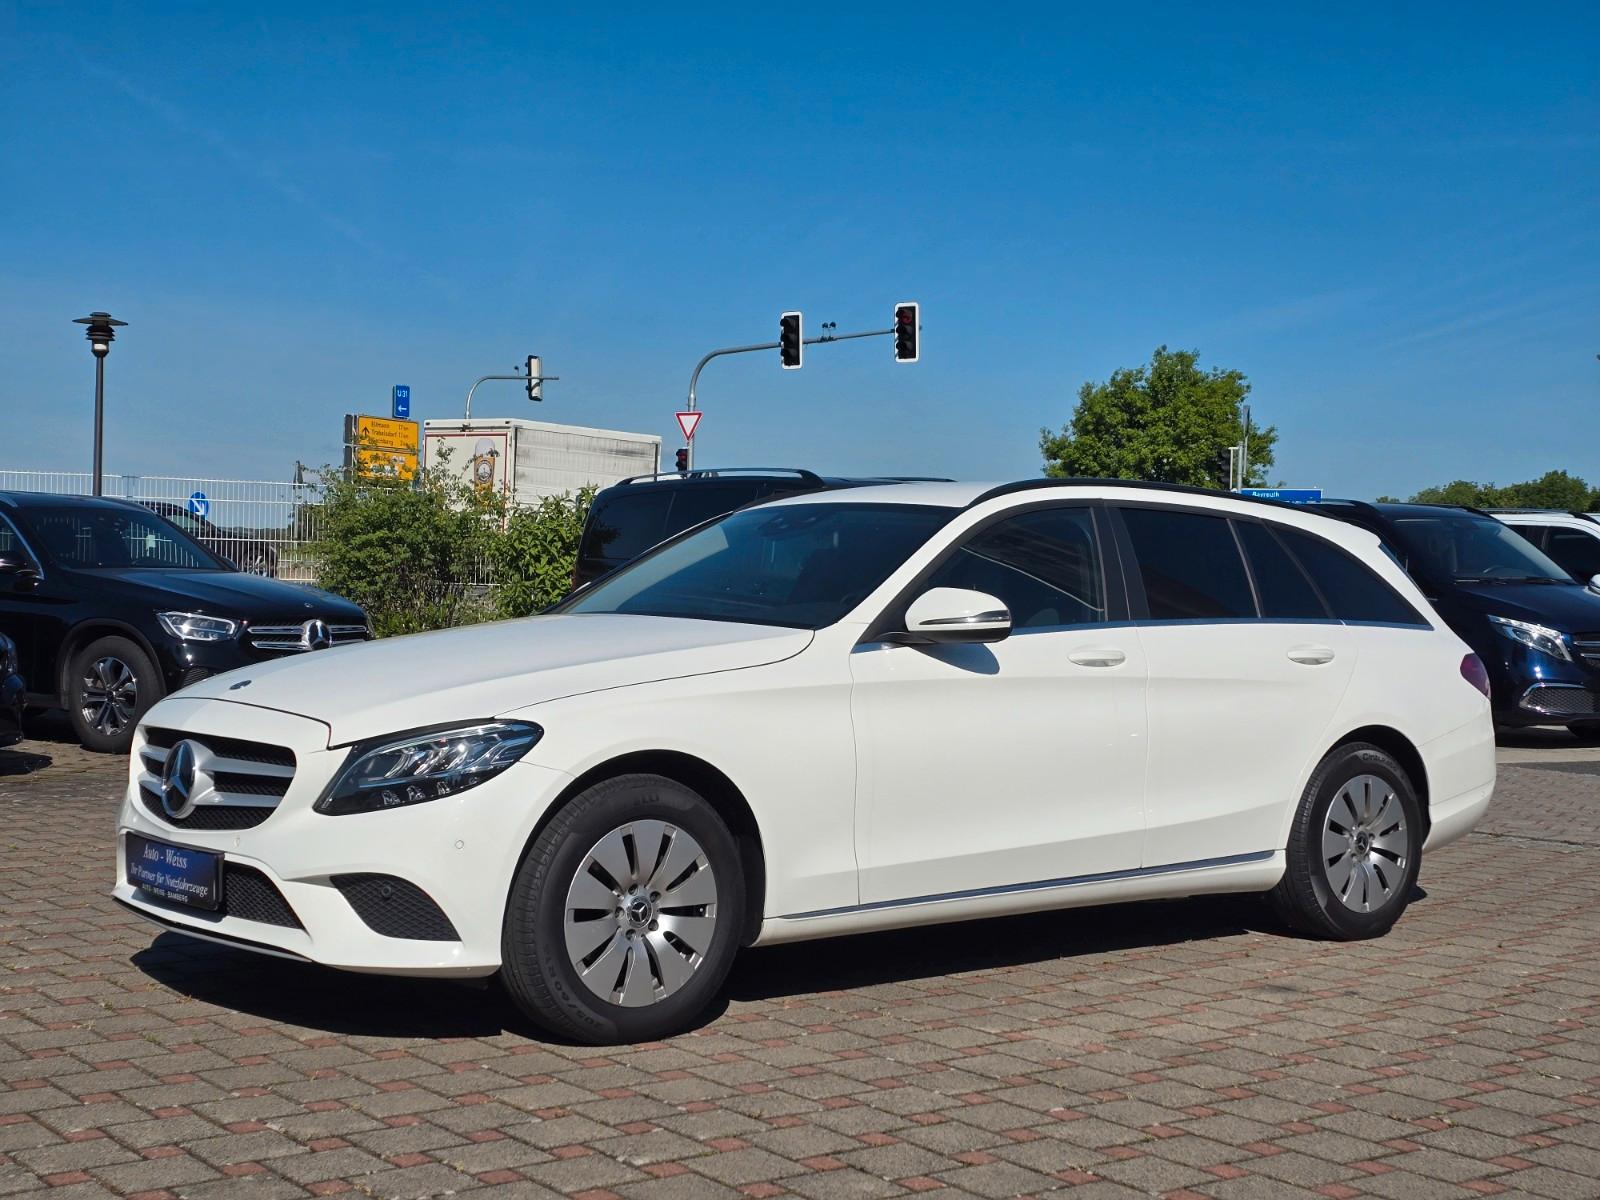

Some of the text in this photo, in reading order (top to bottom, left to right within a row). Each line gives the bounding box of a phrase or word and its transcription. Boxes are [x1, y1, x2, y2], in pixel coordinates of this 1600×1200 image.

[143, 843, 159, 862] Auto
[166, 848, 188, 869] Weiss
[165, 873, 209, 898] Nutzfahrzeuge
